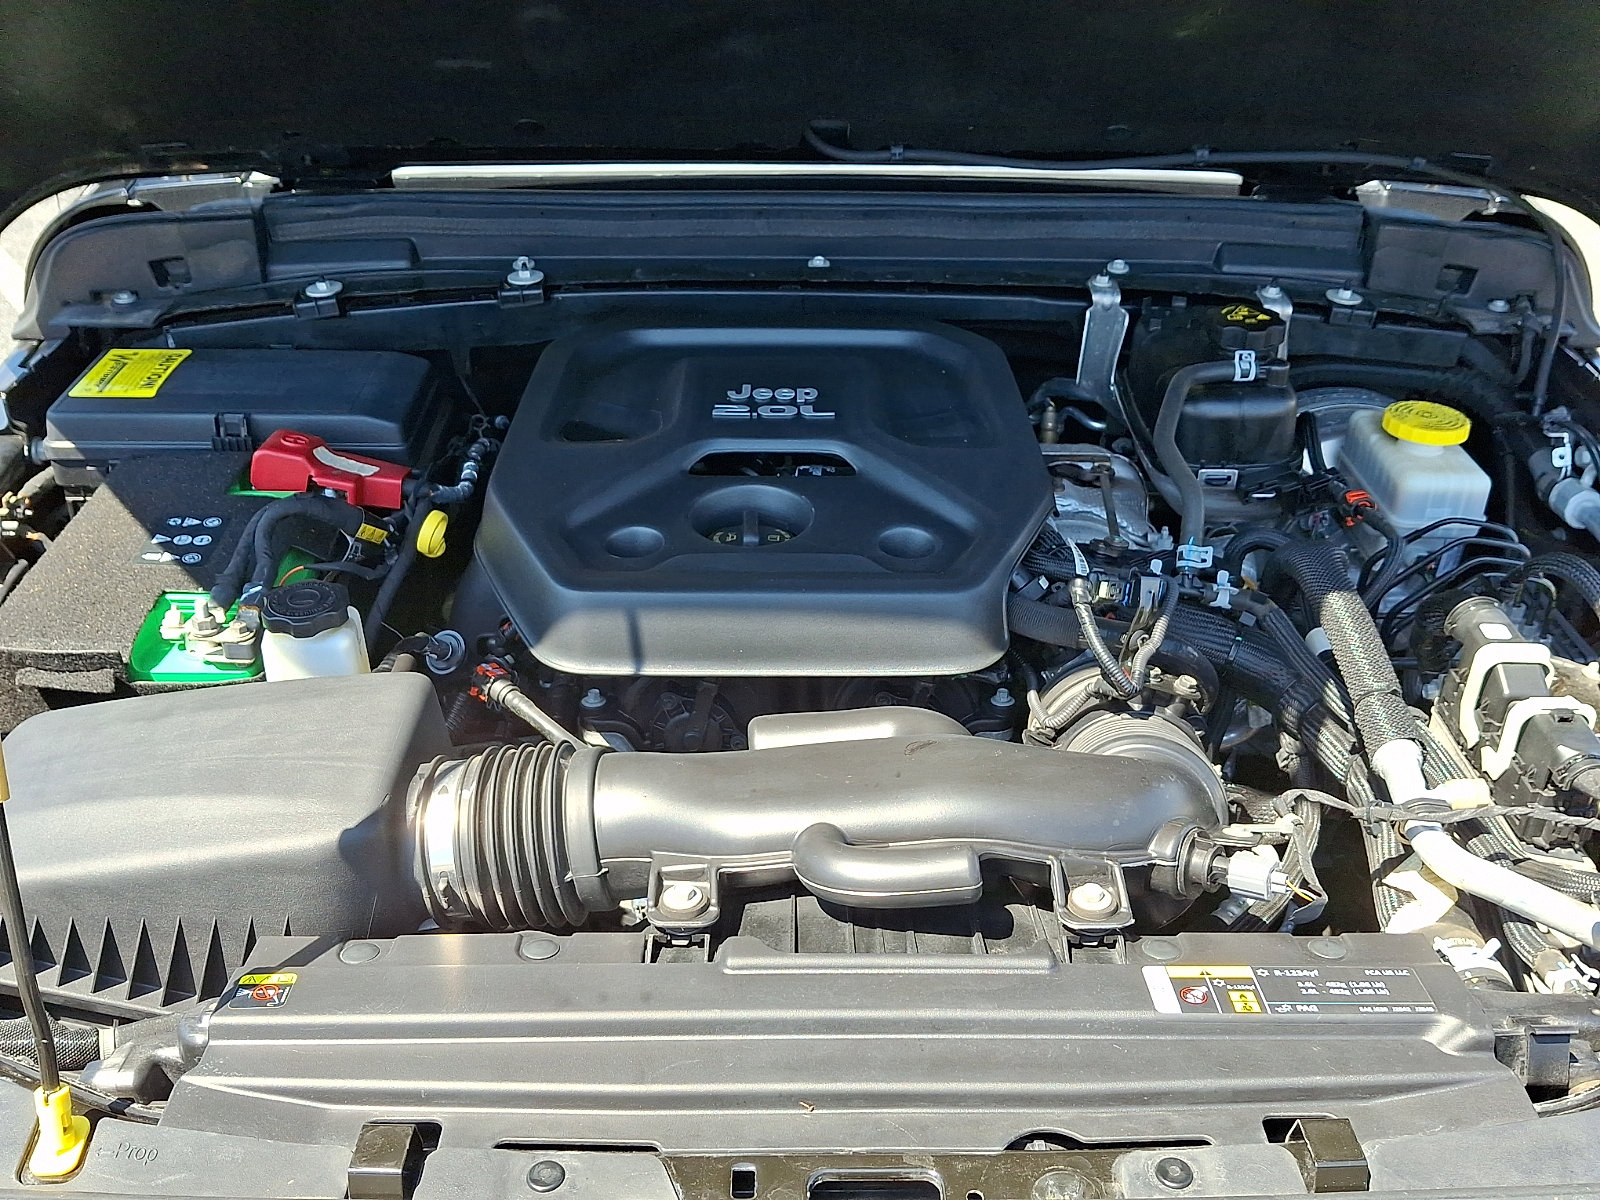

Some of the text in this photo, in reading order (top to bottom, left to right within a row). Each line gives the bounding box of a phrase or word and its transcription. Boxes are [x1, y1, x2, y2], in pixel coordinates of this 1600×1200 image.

[727, 384, 819, 403] Jeep
[712, 404, 836, 419] 2.0L
[115, 1142, 159, 1166] Prop
